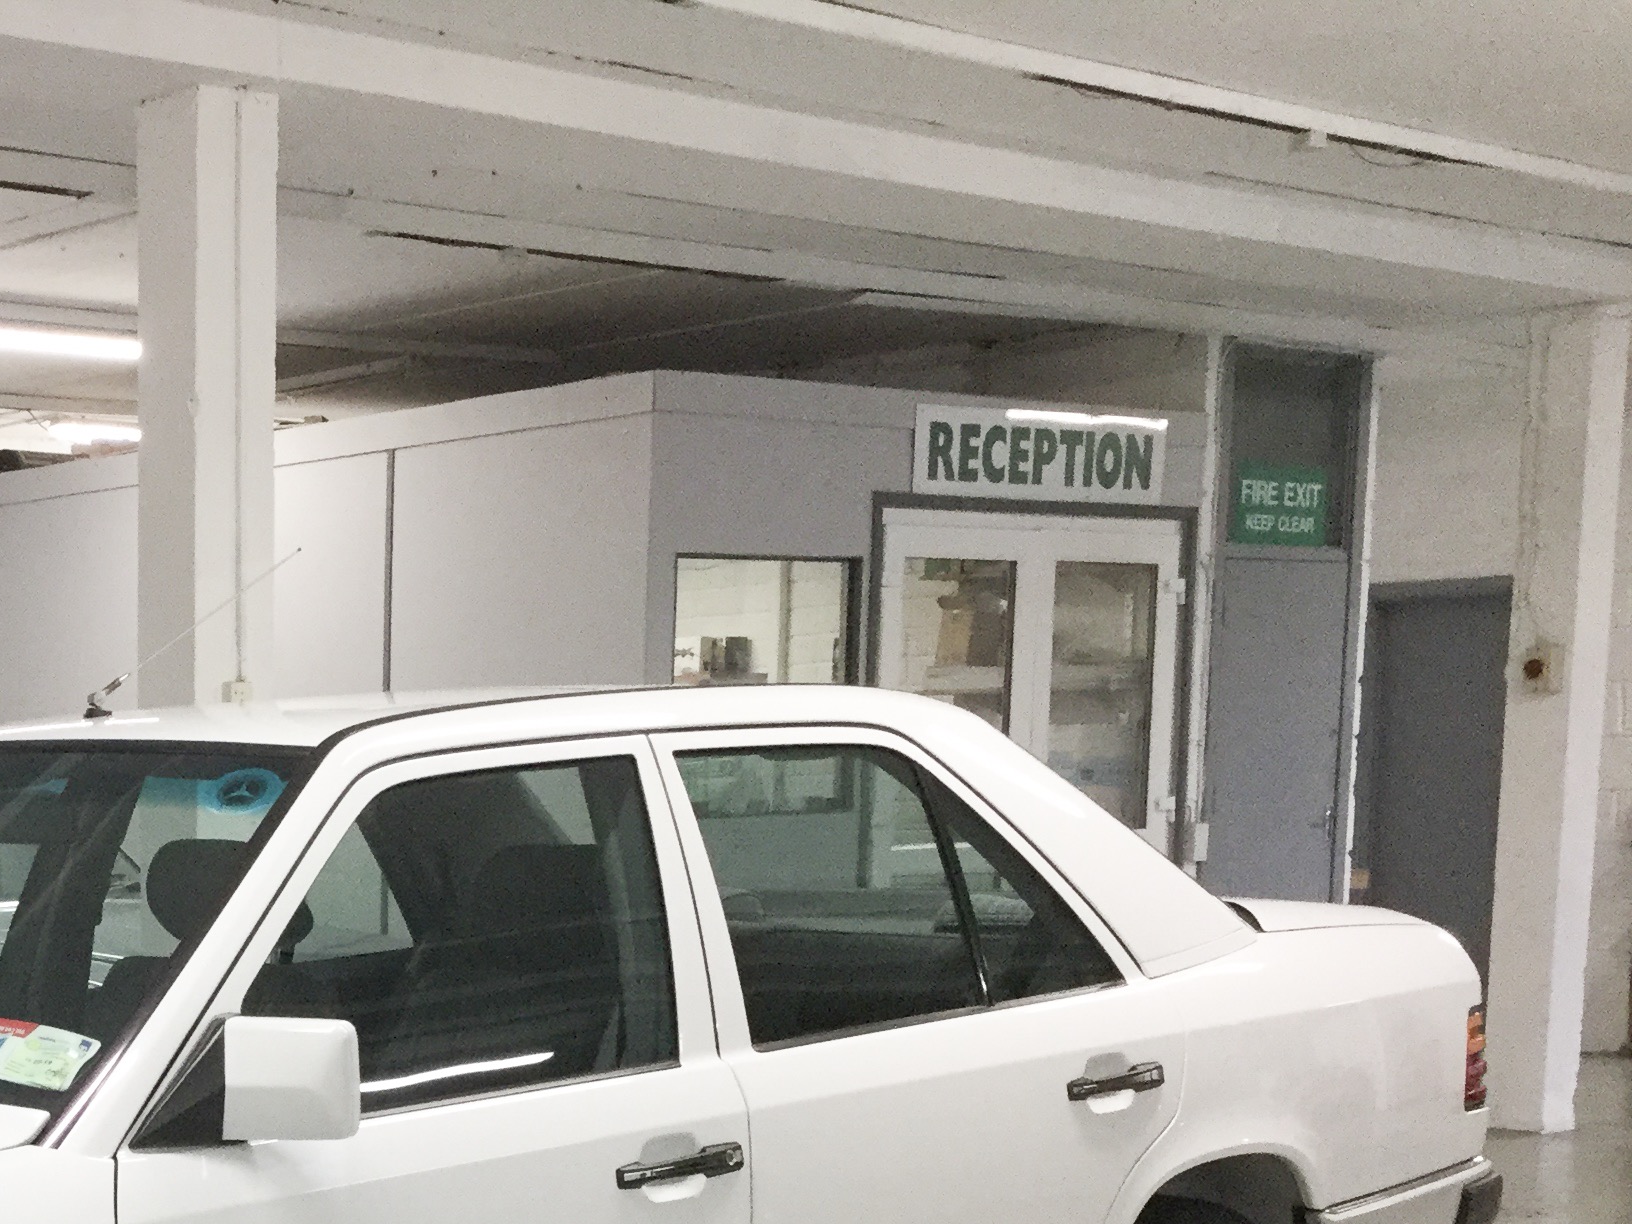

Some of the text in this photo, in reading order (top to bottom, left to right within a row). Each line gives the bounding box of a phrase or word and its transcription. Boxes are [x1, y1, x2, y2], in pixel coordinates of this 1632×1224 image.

[927, 420, 1154, 490] RECEPTION
[1241, 479, 1322, 508] FIRE EXIT
[1246, 514, 1315, 533] KEEP CLEAR
